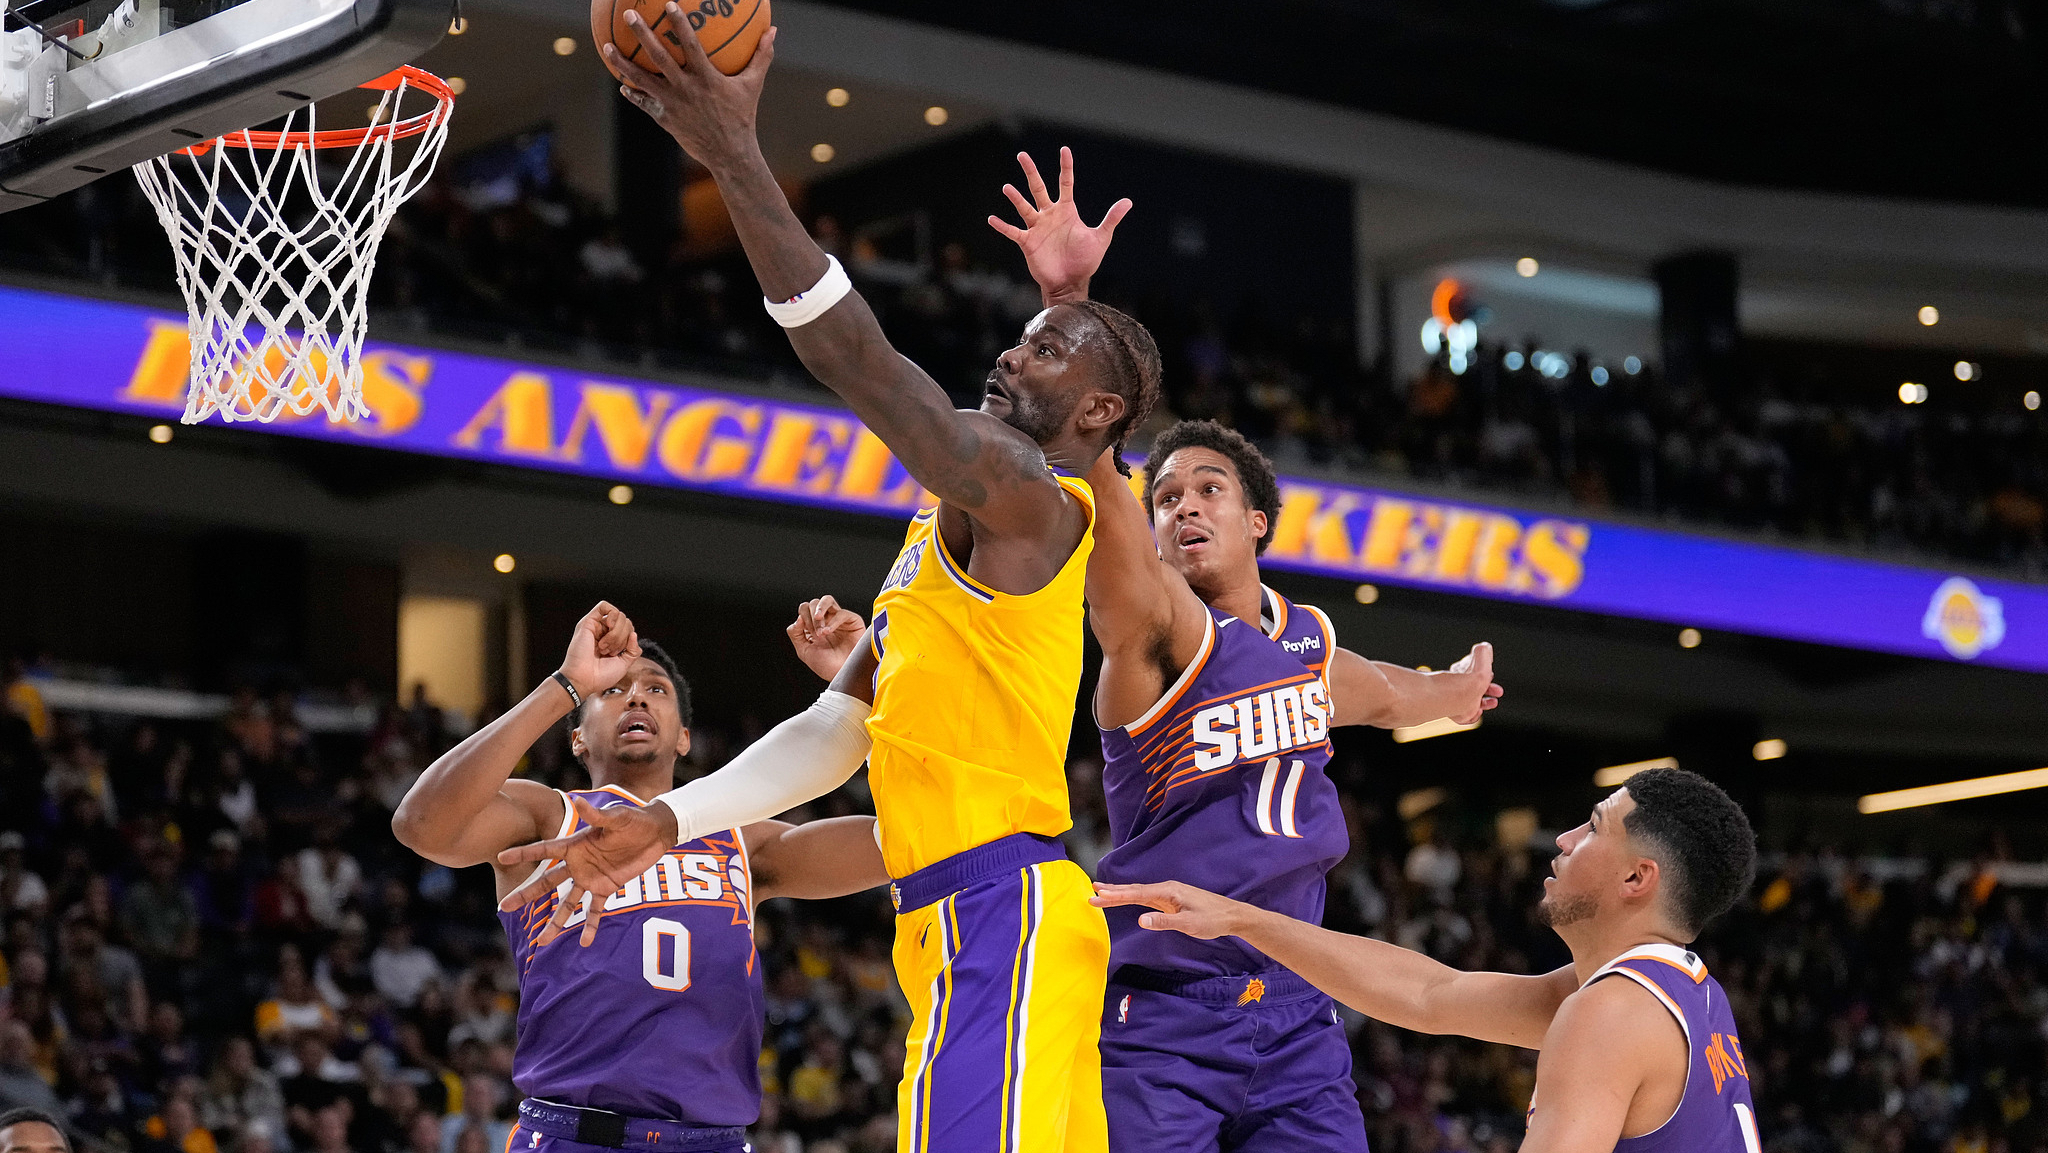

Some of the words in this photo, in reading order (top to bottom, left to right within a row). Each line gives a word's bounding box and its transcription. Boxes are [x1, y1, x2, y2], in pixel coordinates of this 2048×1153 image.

[115, 317, 433, 437] LOS
[448, 371, 943, 508] ANGEL
[1281, 635, 1321, 654] PayPal
[1193, 681, 1327, 772] SUNS
[1256, 757, 1304, 838] 11
[643, 917, 691, 992] 0
